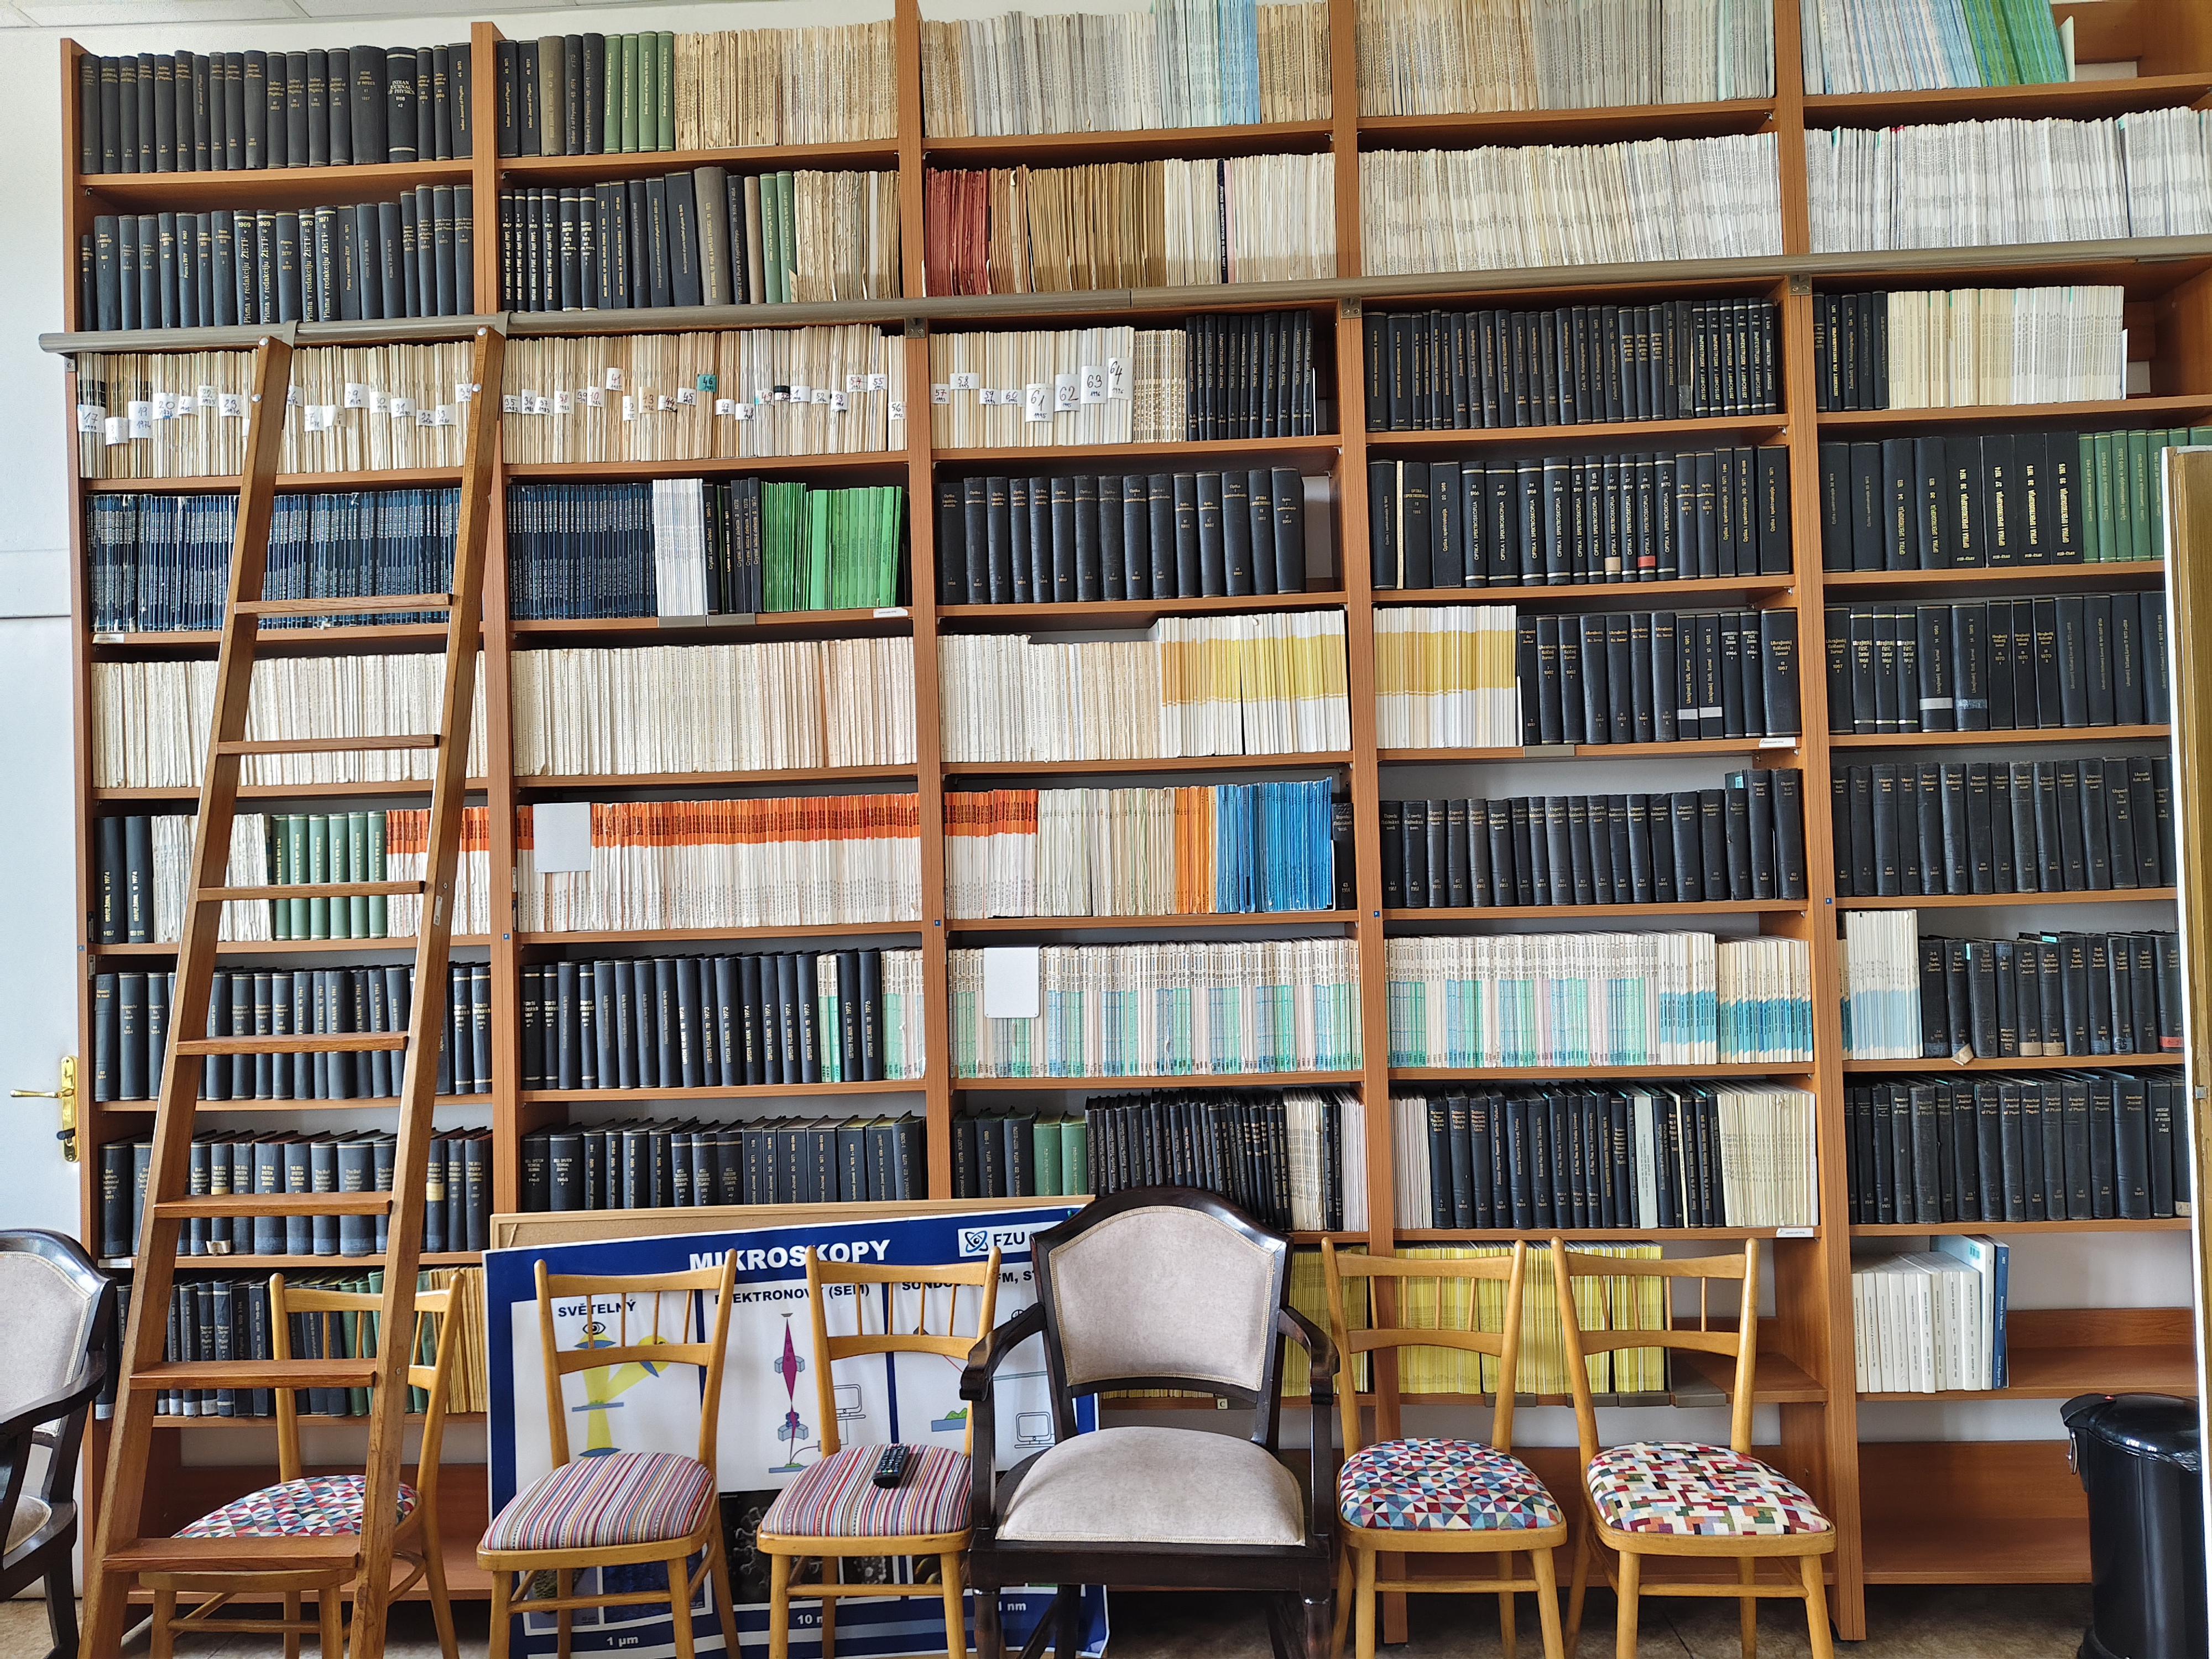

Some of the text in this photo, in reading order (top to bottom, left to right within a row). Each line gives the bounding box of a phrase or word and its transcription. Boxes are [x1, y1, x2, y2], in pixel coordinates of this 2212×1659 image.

[242, 263, 252, 294] redakciju
[305, 260, 313, 293] redakciju
[1110, 361, 1122, 385] 64
[612, 374, 620, 384] 41
[958, 376, 968, 384] 58
[1087, 375, 1102, 388] 63
[644, 394, 654, 404] 43
[762, 392, 772, 401] 49
[985, 391, 994, 399] 59
[1060, 386, 1078, 401] 62
[224, 400, 237, 409] 23
[1031, 390, 1045, 411] 61
[138, 407, 147, 416] 19
[744, 406, 753, 415] 48
[84, 412, 98, 424] 17
[137, 421, 151, 429] 1974
[1996, 491, 2004, 527] SPEKTROSKOPIJA
[2060, 488, 2068, 523] SPEKTROSKOPIJA
[993, 1232, 1025, 1246] FZU
[1007, 1601, 1026, 1611] nm
[796, 1614, 823, 1625] 10 n
[607, 1635, 639, 1647] 1 µm
